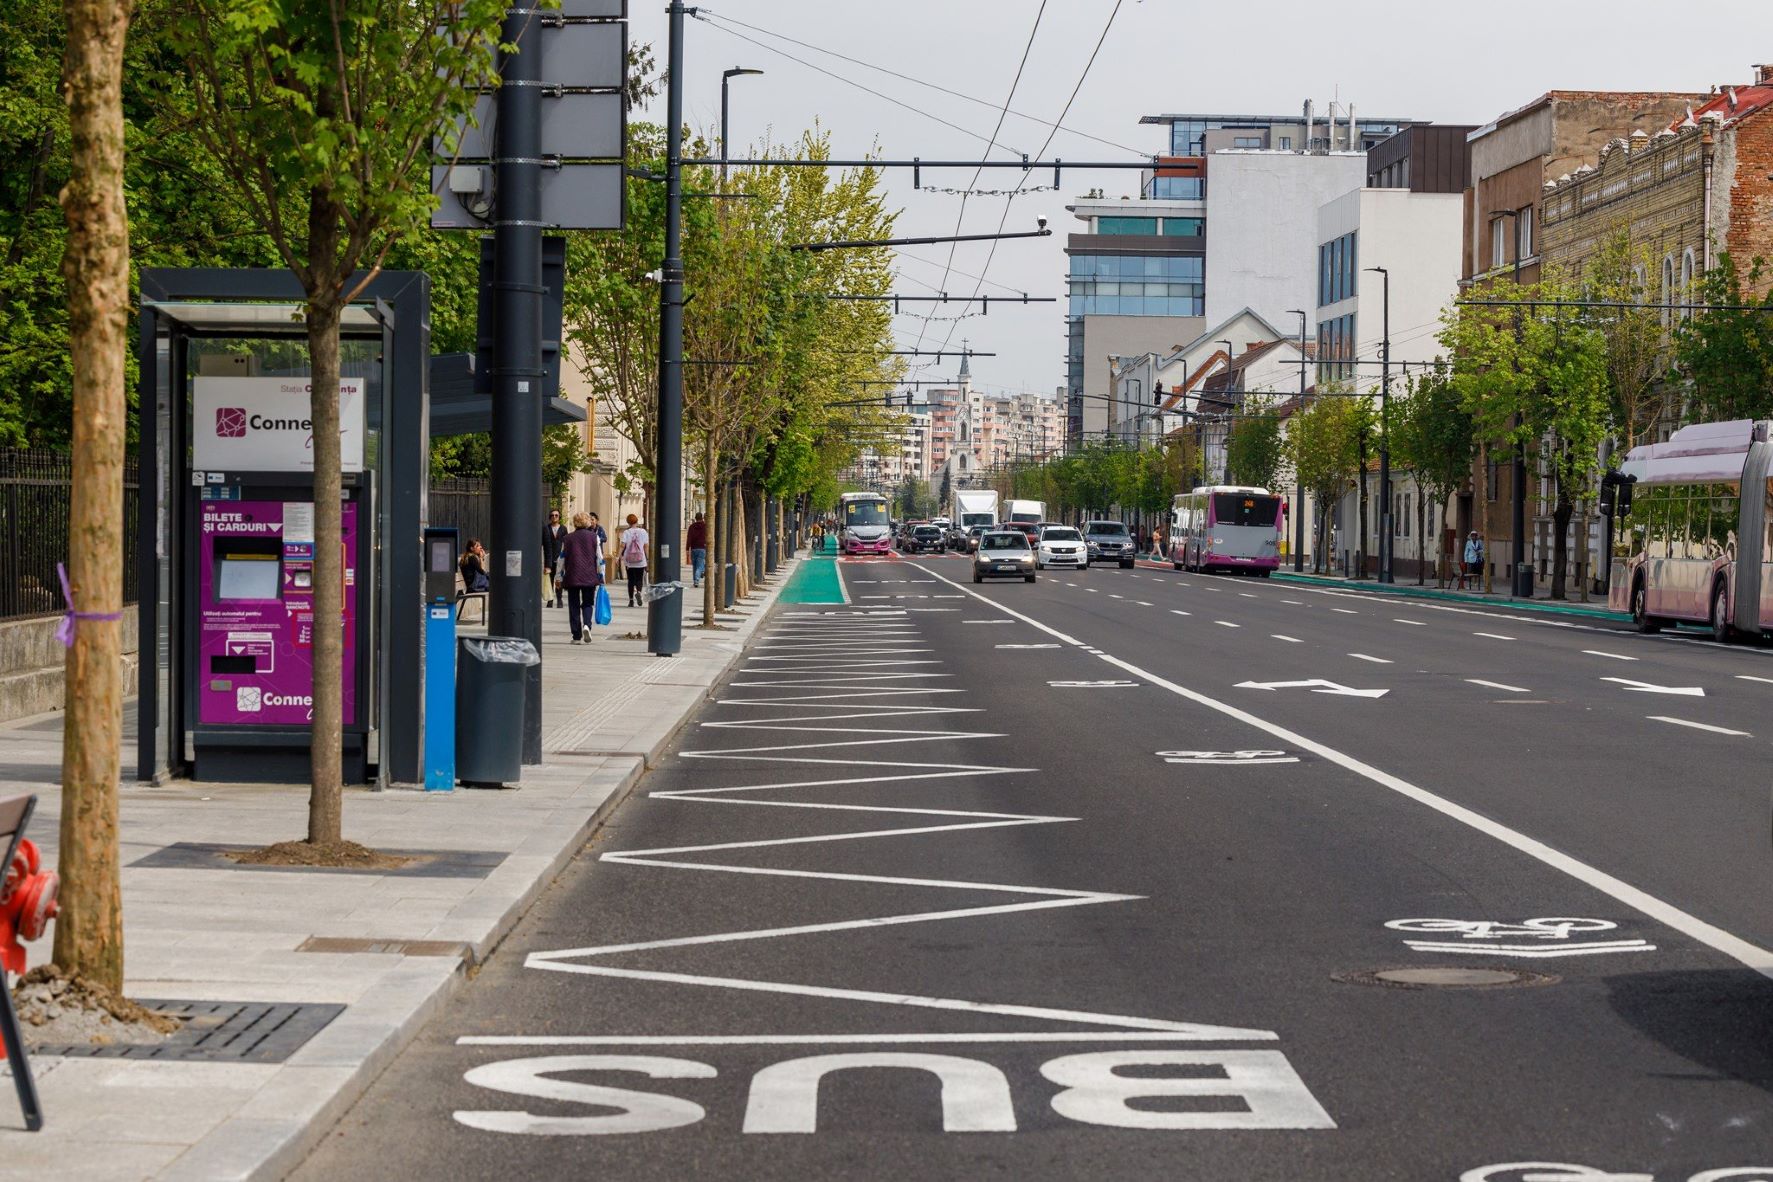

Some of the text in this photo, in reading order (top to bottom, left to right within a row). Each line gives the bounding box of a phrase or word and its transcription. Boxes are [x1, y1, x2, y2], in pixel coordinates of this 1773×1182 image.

[249, 413, 313, 431] Conne
[203, 512, 242, 522] BILETE
[203, 522, 266, 534] ȘI CARDURI
[263, 692, 313, 706] Conne
[452, 1049, 1338, 1135] BUS
